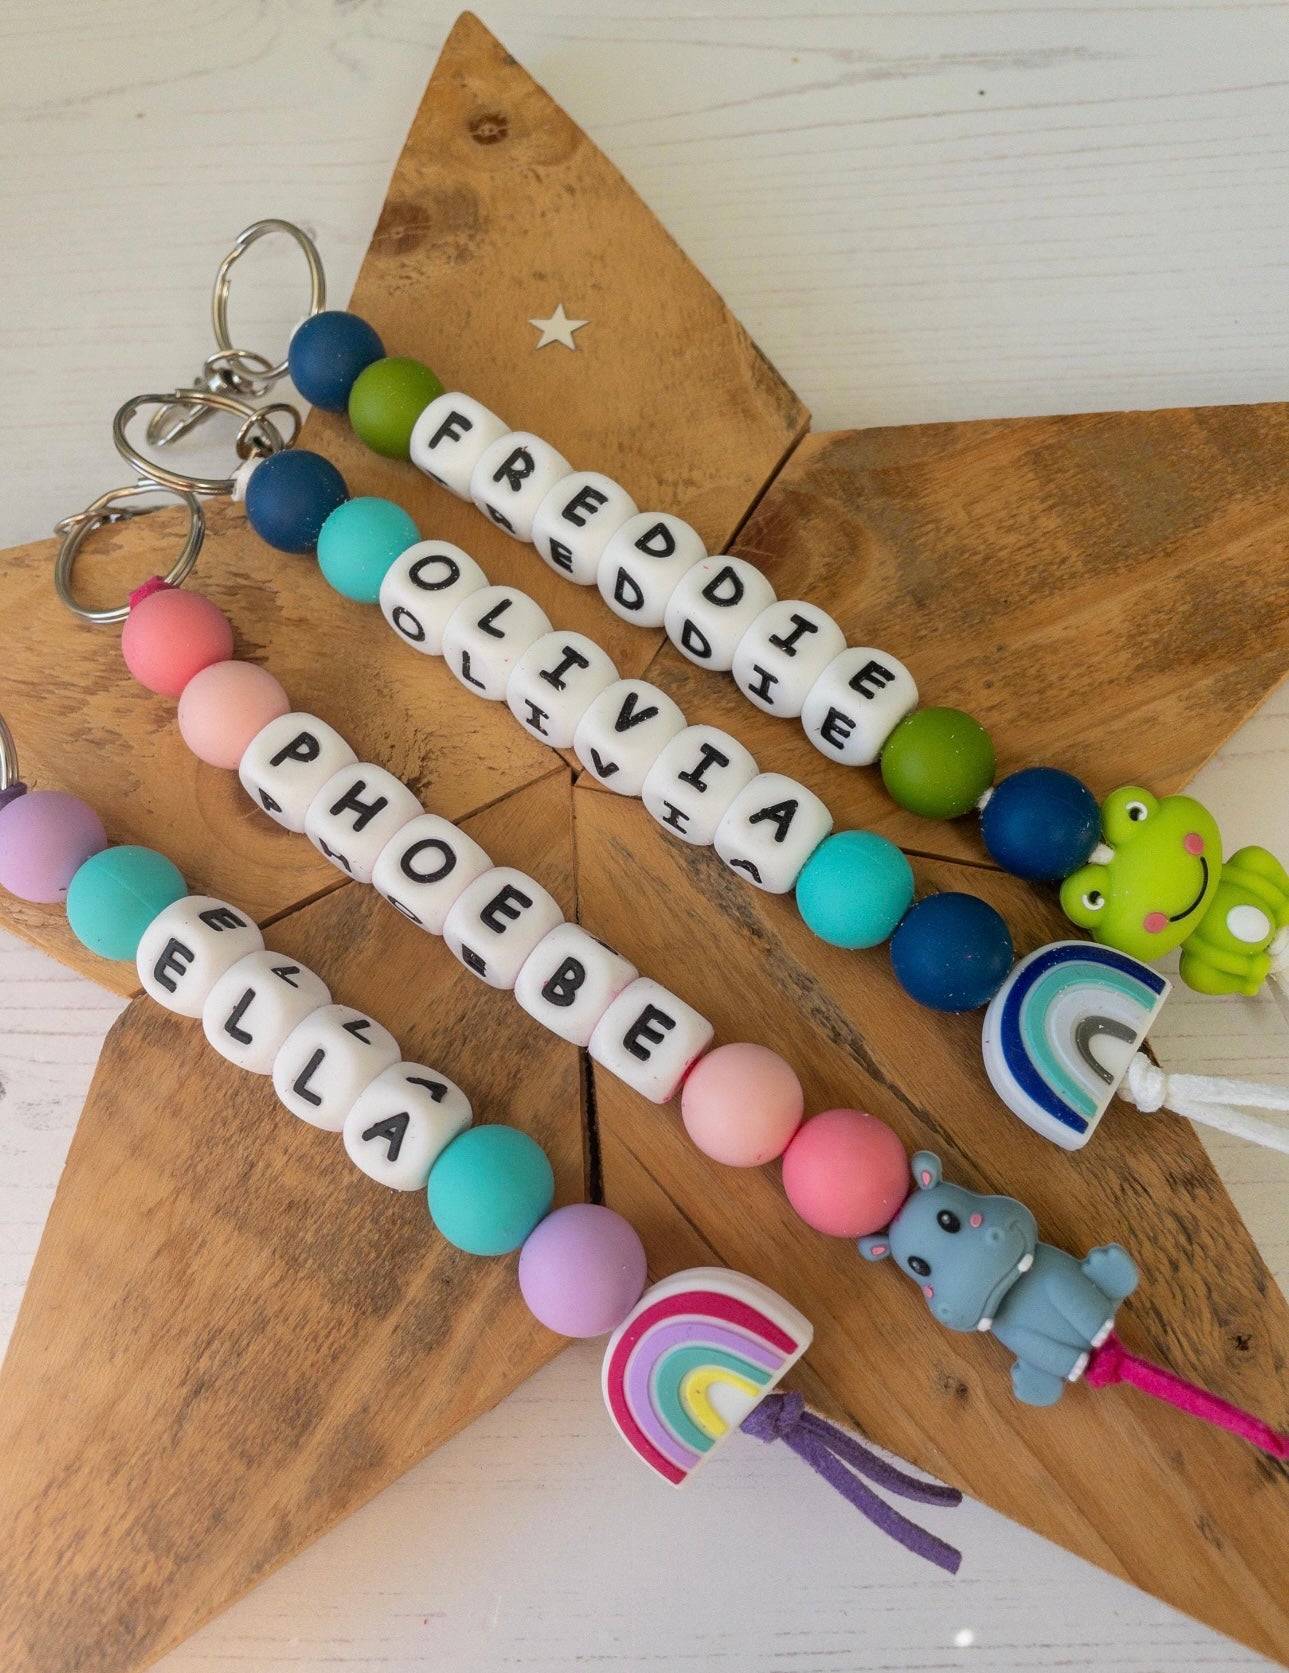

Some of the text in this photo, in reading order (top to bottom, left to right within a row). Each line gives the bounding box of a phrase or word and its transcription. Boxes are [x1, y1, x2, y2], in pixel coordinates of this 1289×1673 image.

[408, 554, 799, 843] OLIVIA
[428, 410, 896, 700] FREDDIE
[269, 731, 677, 1061] PHOEBE
[153, 937, 410, 1162] ELLA
